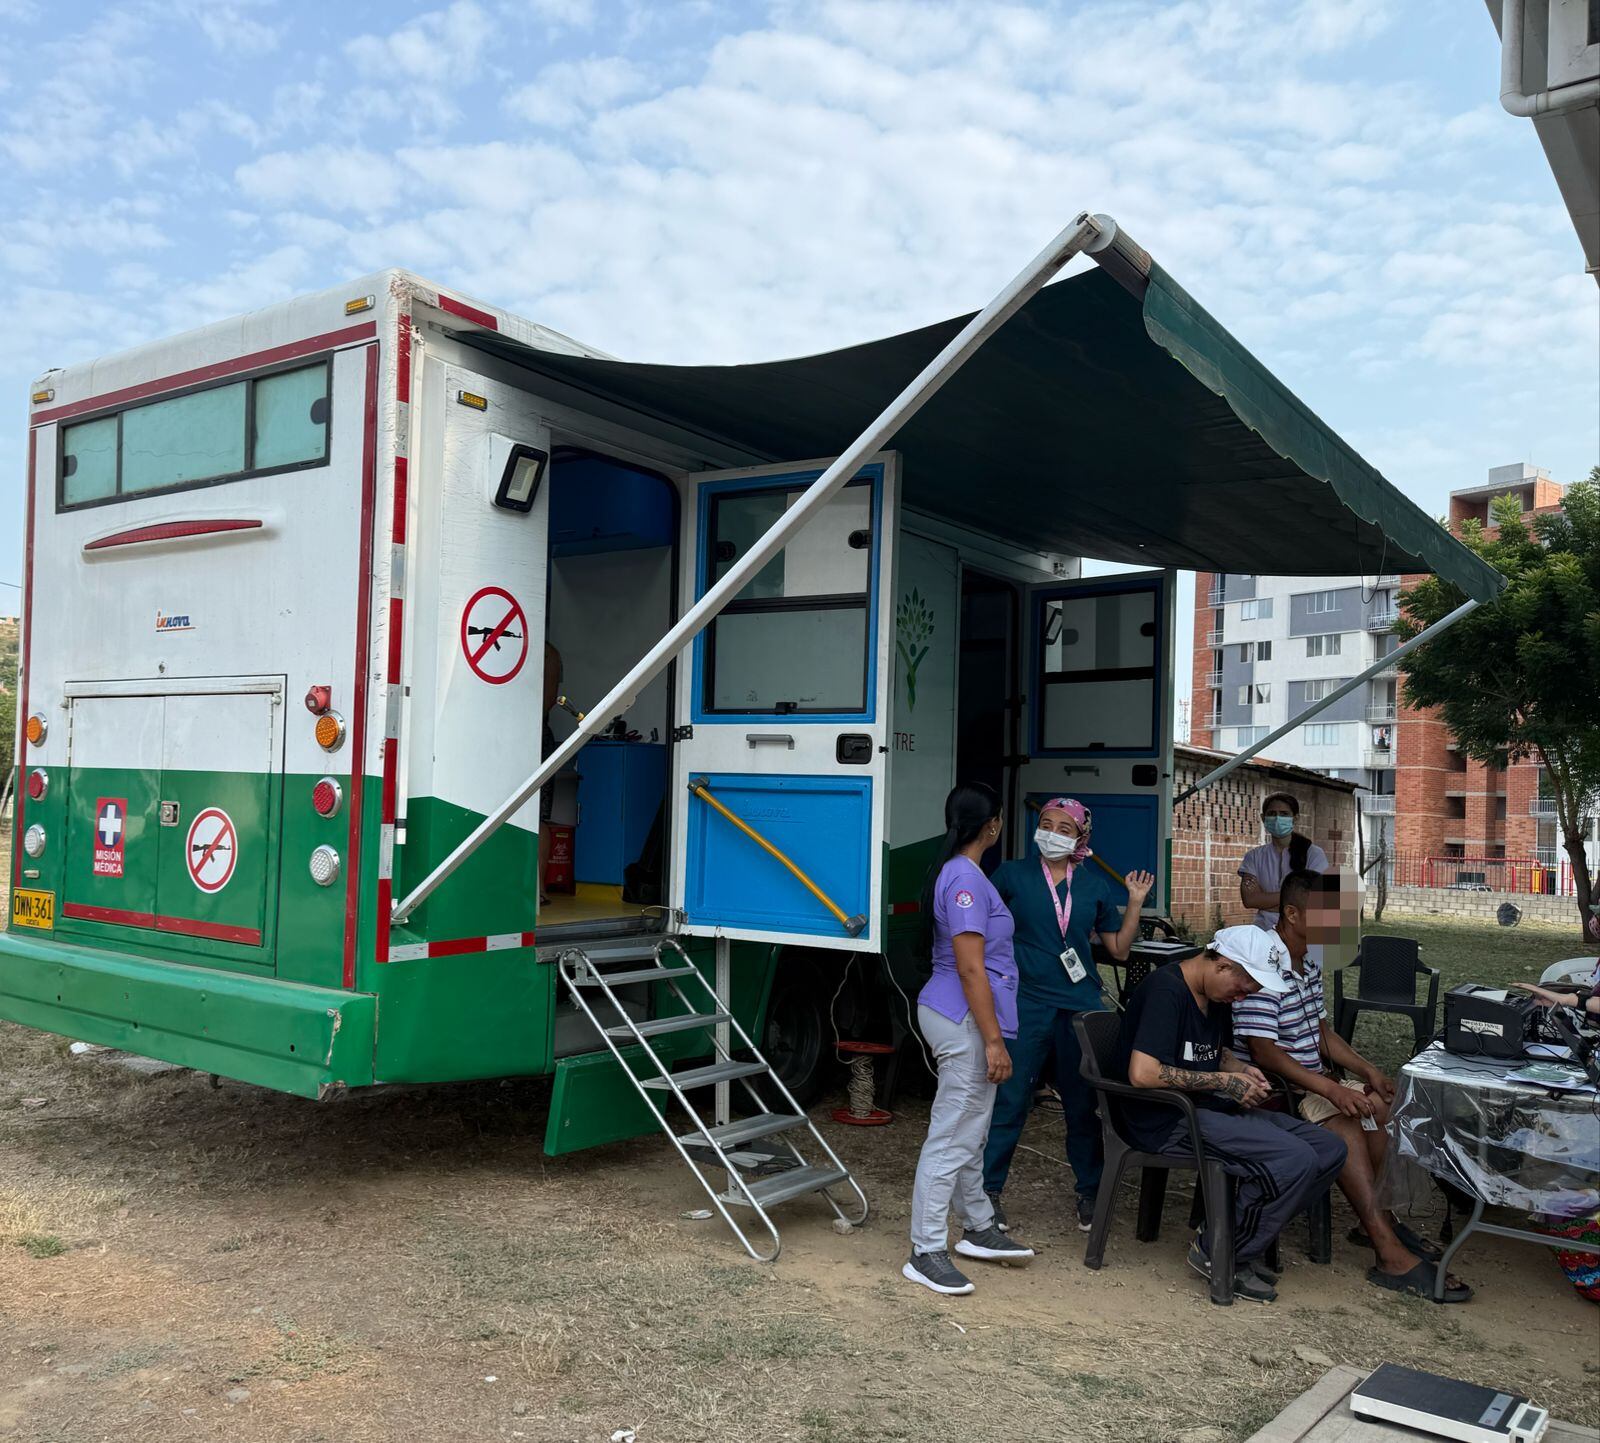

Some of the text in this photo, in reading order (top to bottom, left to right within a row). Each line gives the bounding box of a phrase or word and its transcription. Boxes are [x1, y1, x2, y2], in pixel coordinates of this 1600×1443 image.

[892, 732, 915, 752] TRE
[96, 849, 122, 861] MISIÓN
[94, 860, 123, 874] MÉDICA
